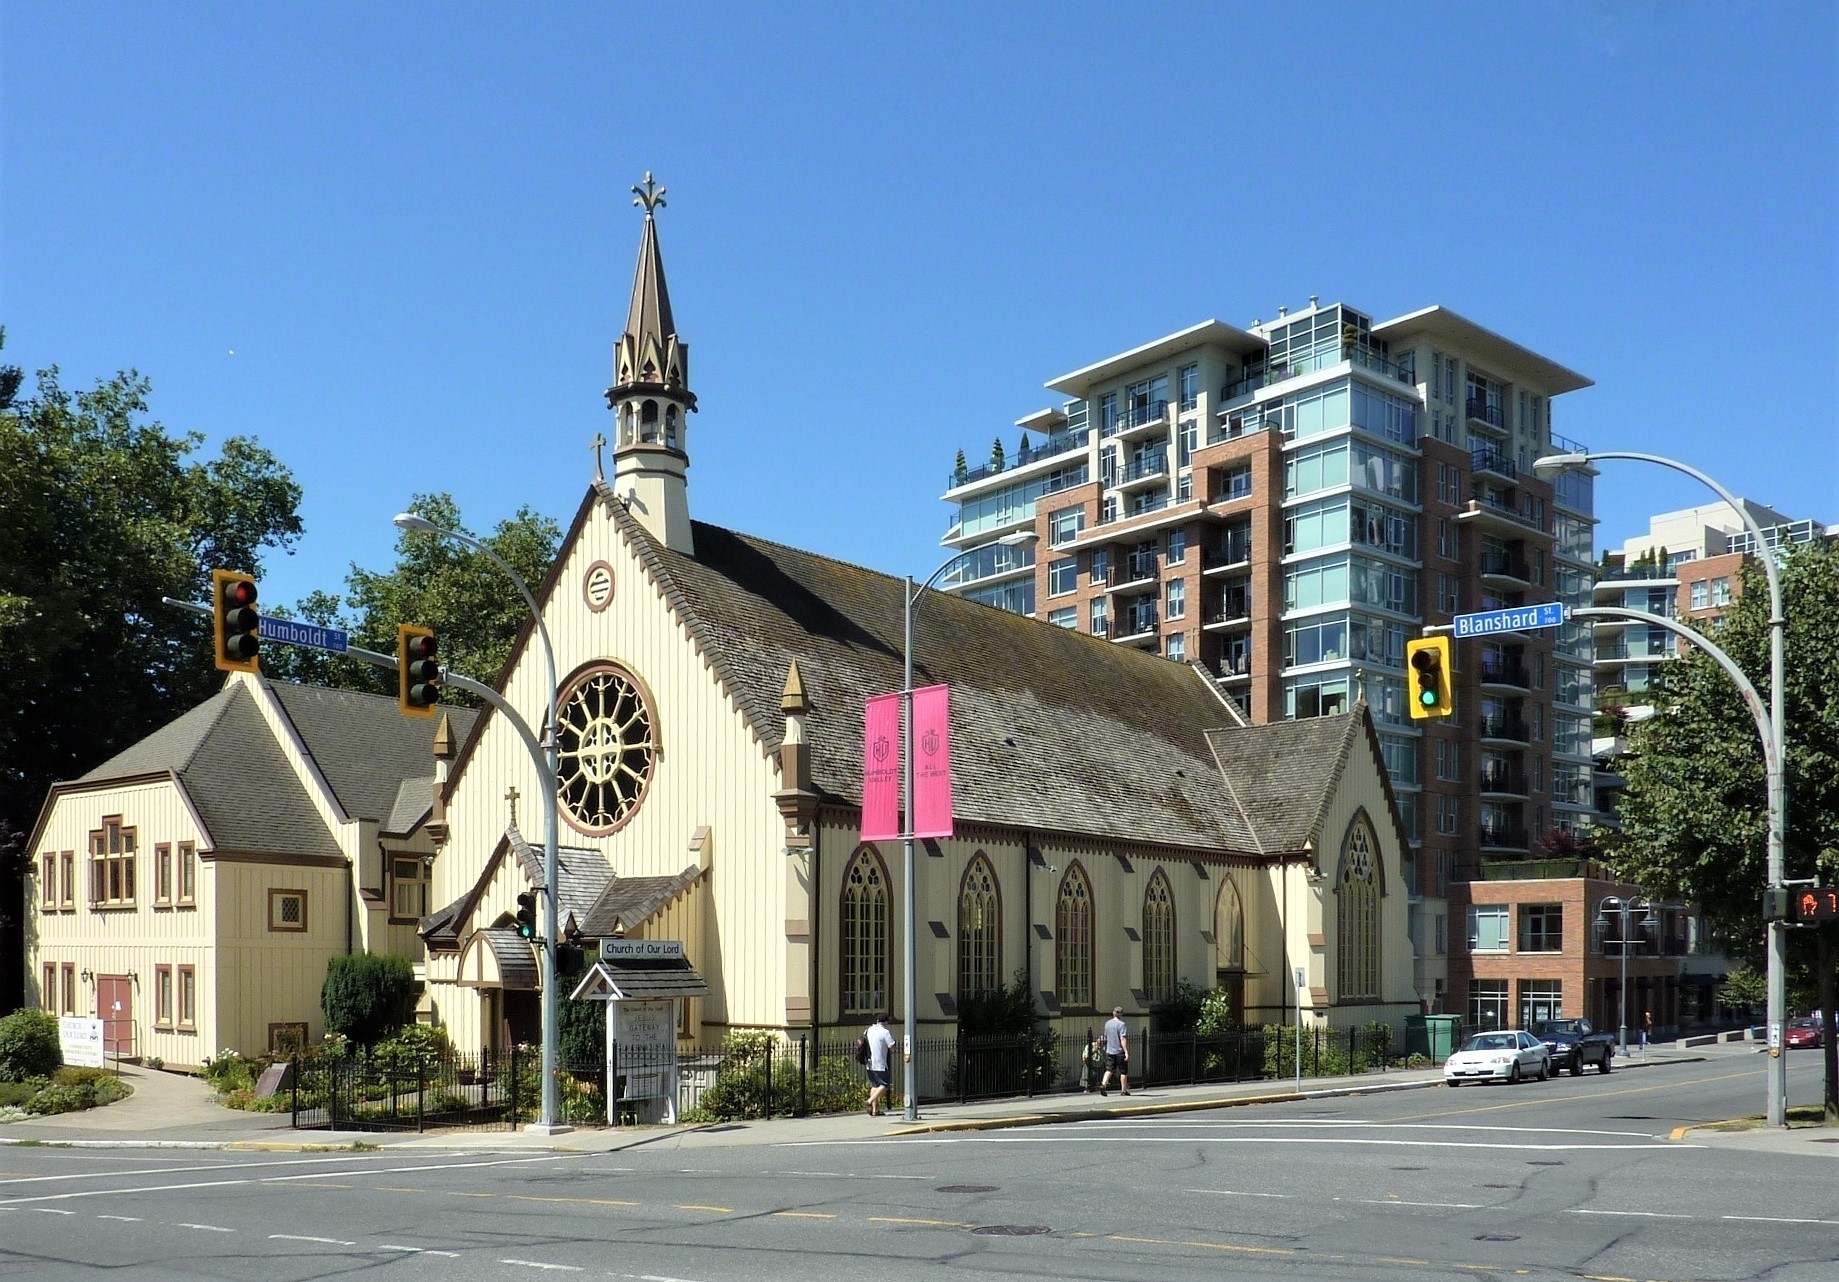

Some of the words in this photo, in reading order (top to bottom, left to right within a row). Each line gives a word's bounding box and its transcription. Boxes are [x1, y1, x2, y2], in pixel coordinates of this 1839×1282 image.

[1459, 608, 1538, 635] Blanshard
[1544, 607, 1554, 615] St.
[259, 619, 328, 647] Humboldt
[1827, 893, 1836, 913] 7
[606, 943, 634, 954] Church
[636, 943, 645, 954] of
[647, 944, 660, 954] Our
[663, 943, 679, 954] Lord
[634, 1013, 656, 1022] JESUS
[629, 1024, 659, 1032] GATEWAY
[632, 1034, 641, 1042] TO
[645, 1033, 658, 1041] THE
